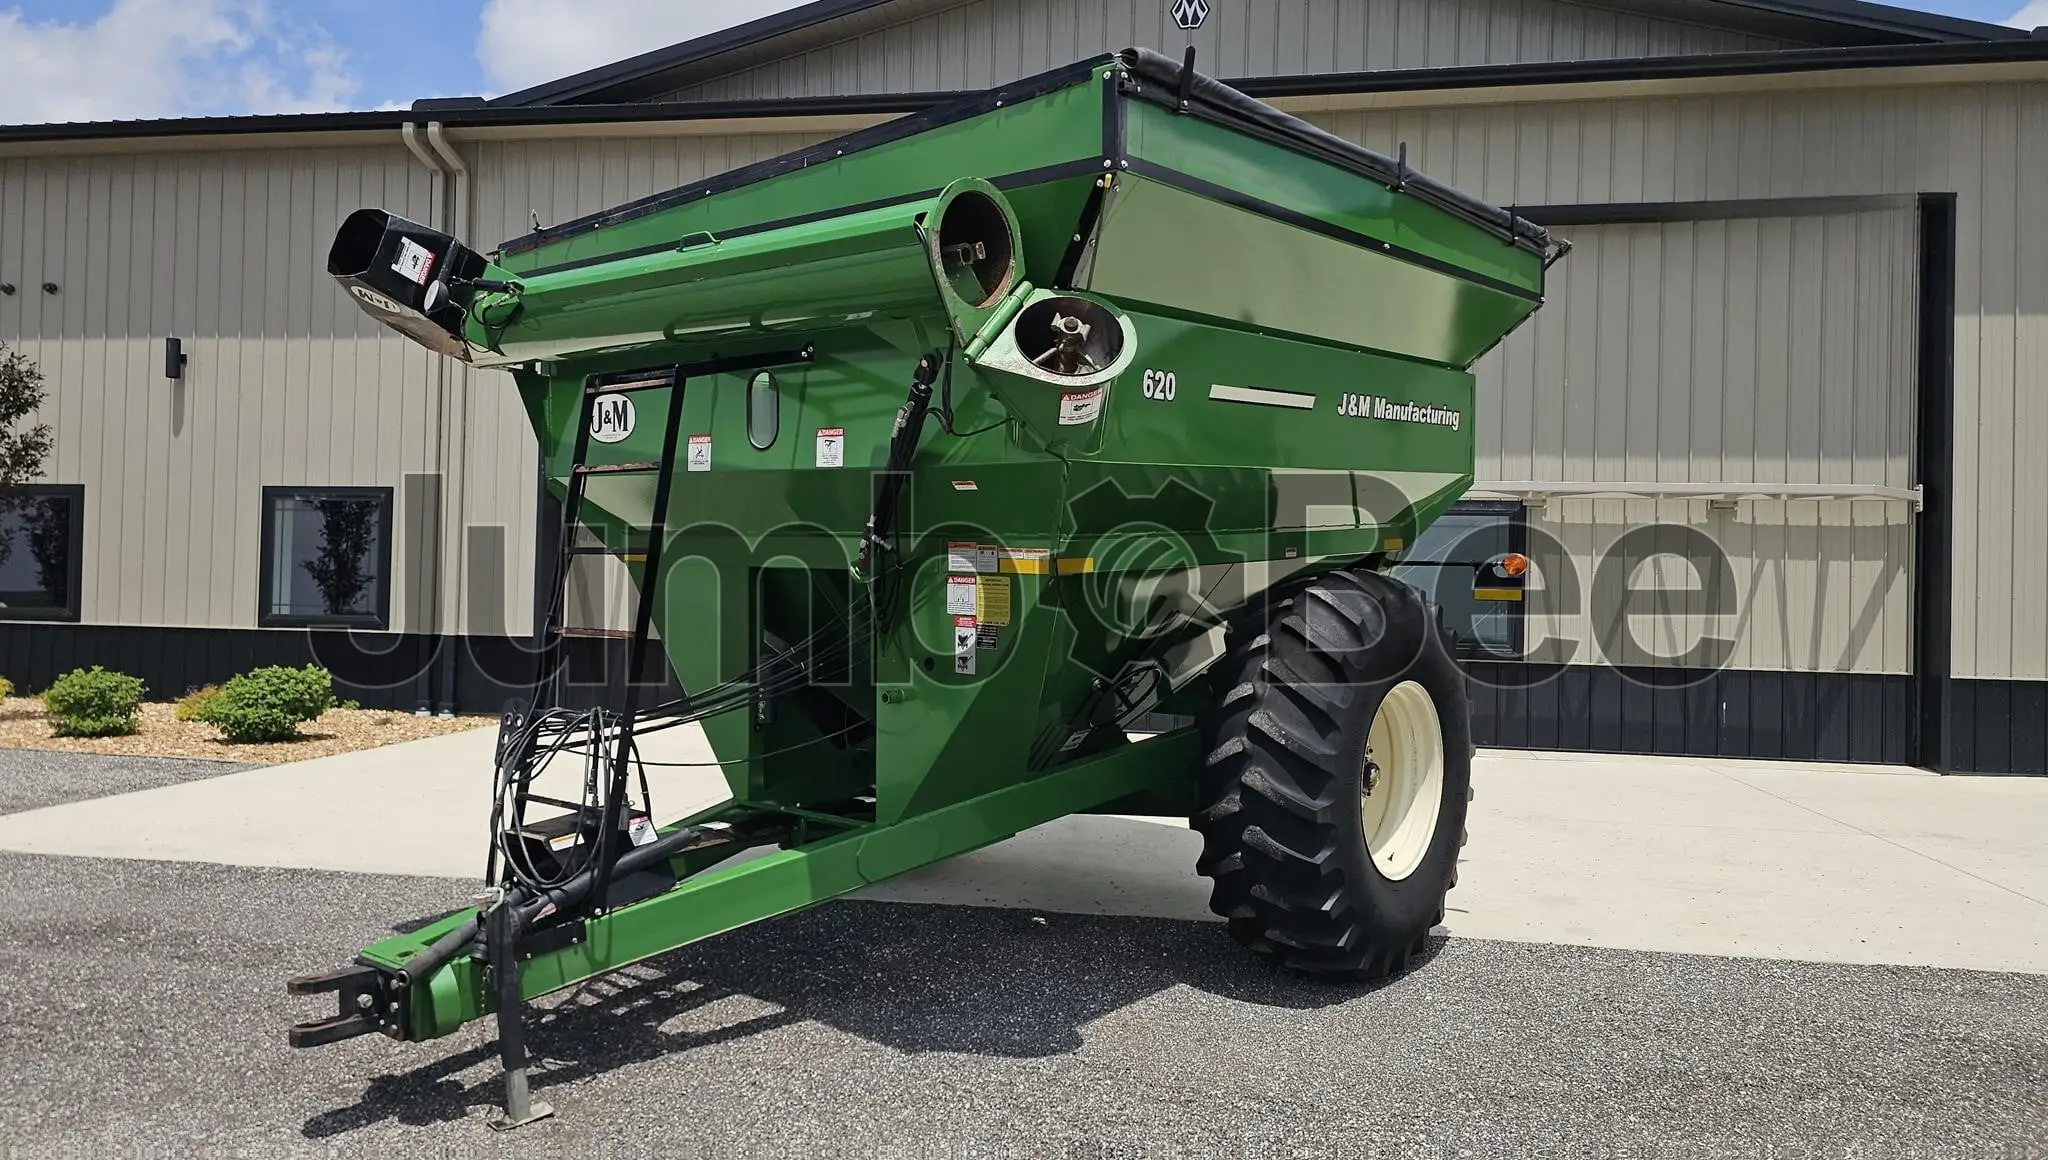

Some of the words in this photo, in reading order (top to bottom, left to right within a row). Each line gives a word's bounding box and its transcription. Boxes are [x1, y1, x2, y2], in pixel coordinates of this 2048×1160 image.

[1070, 388, 1102, 401] DANGER
[1142, 368, 1176, 401] 620
[591, 399, 628, 434] J&M
[1337, 392, 1371, 418] J&M
[1373, 396, 1460, 432] Manufacturing
